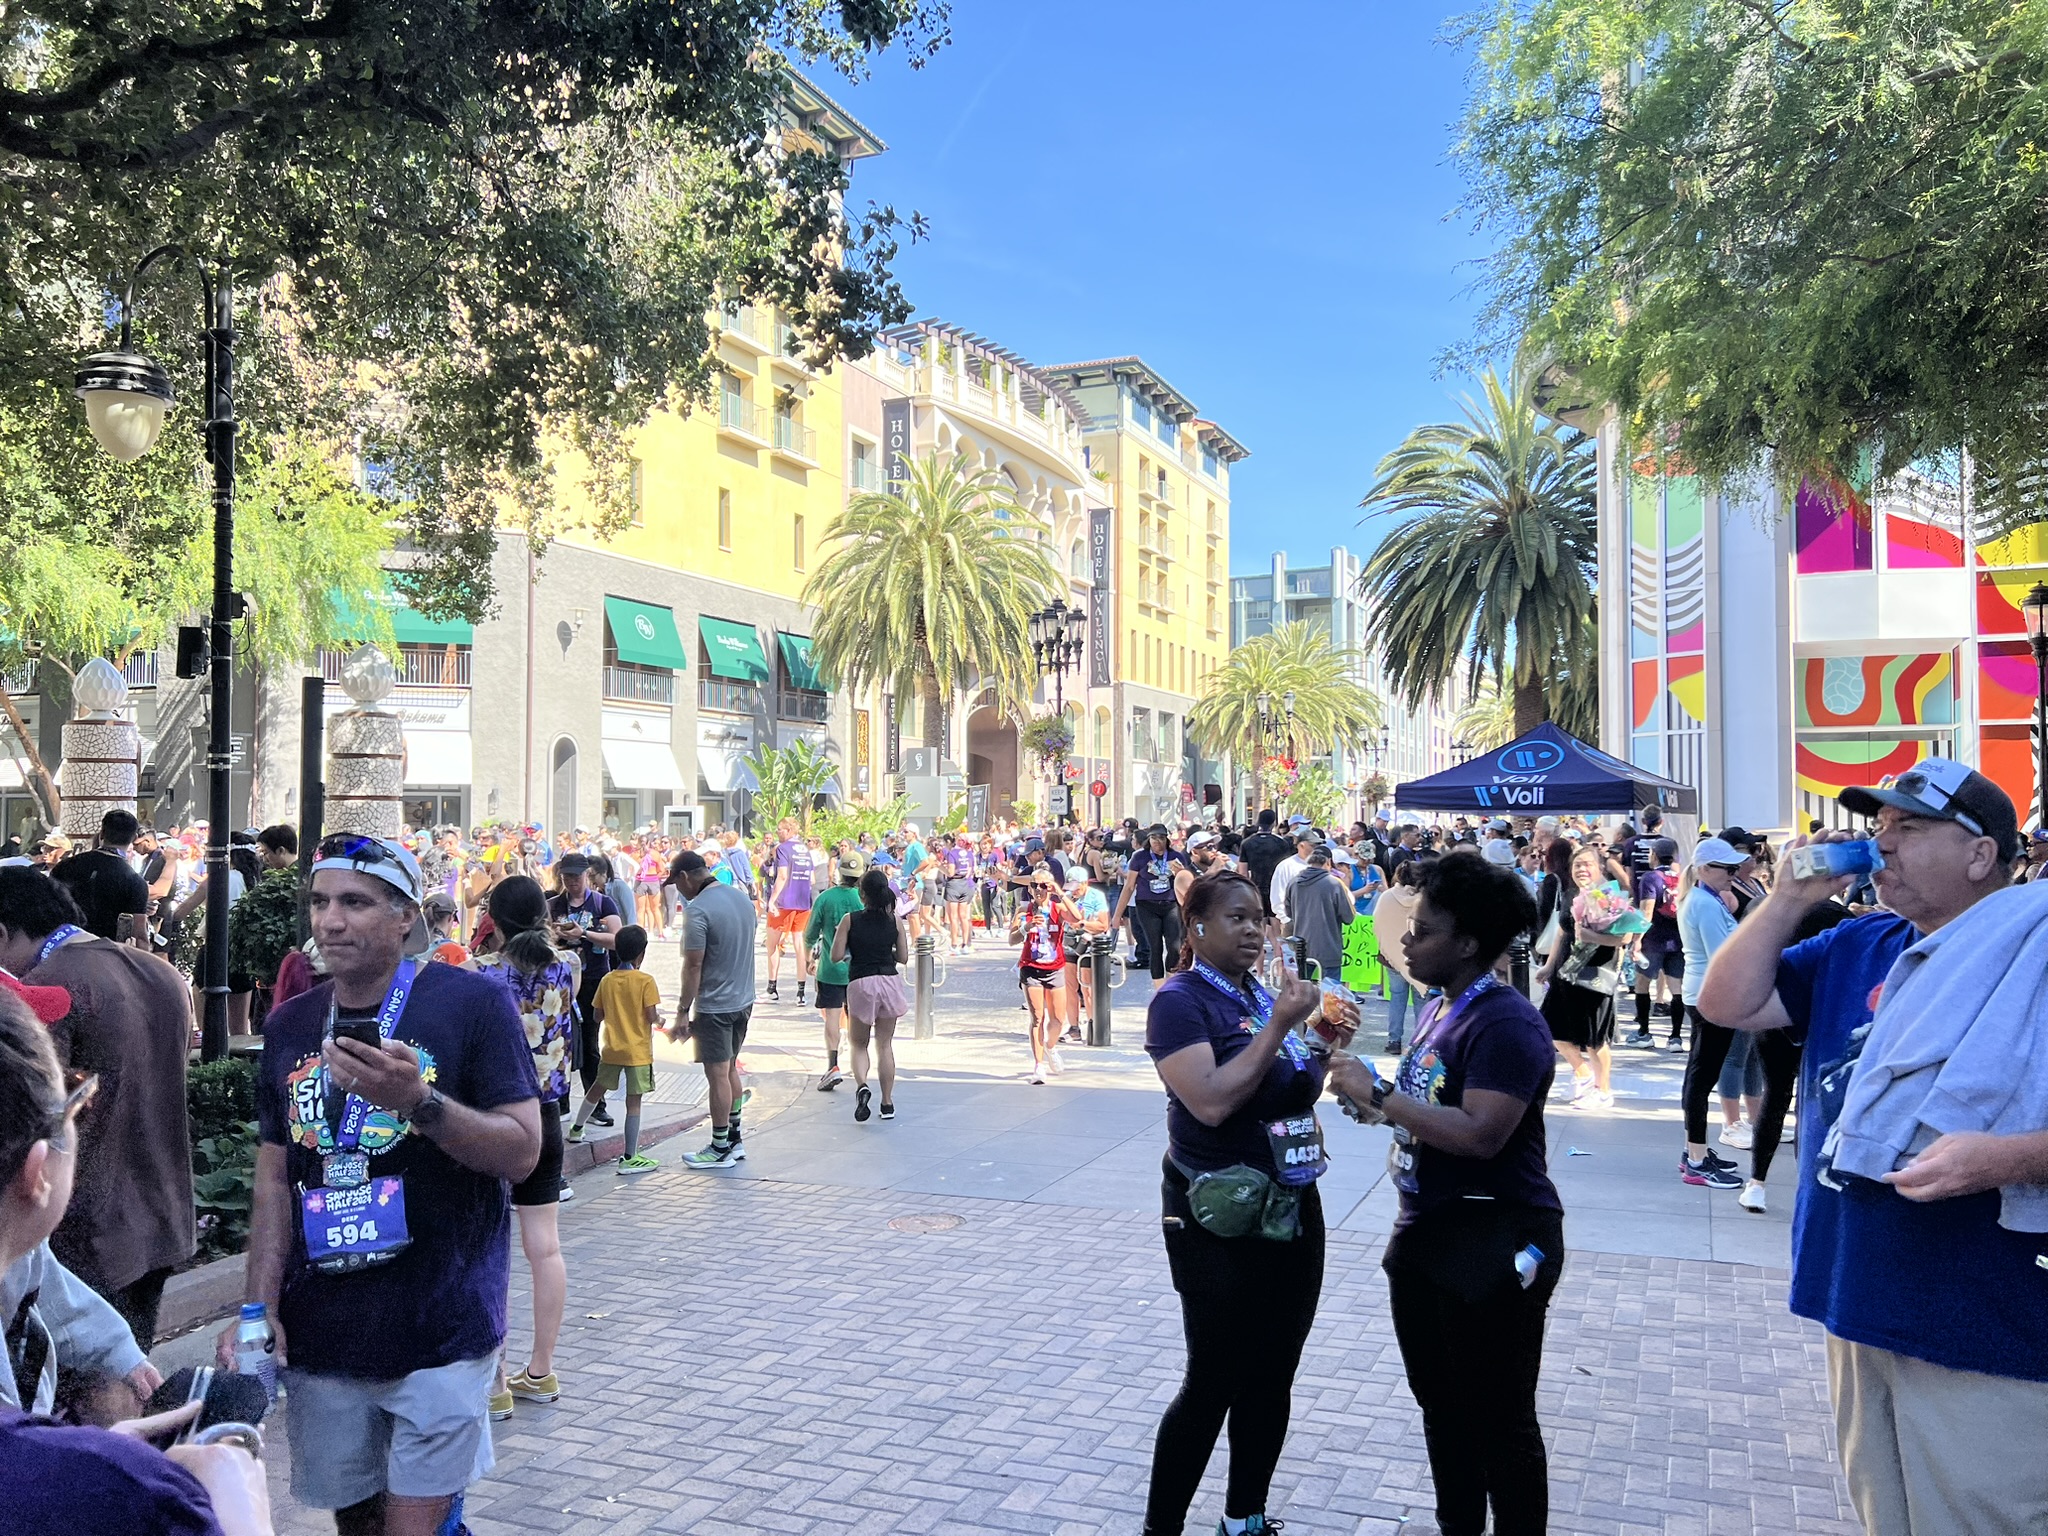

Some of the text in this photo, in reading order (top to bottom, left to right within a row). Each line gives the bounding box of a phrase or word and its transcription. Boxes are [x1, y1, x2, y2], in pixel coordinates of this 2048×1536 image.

[890, 419, 904, 494] HOTEL
[1094, 524, 1106, 684] HOTEL VALENCIA
[1492, 775, 1548, 784] Voli
[1502, 786, 1544, 806] Voli
[1665, 788, 1679, 808] Voli
[1213, 976, 1237, 993] HALF
[378, 987, 405, 1040] SAN JOS
[343, 1105, 362, 1135] 2024
[327, 1163, 343, 1172] SAN
[328, 1168, 363, 1179] HALF 2024
[325, 1189, 346, 1204] SAN
[326, 1197, 352, 1212] HALF
[351, 1193, 373, 1207] 2024
[326, 1220, 378, 1248] 594
